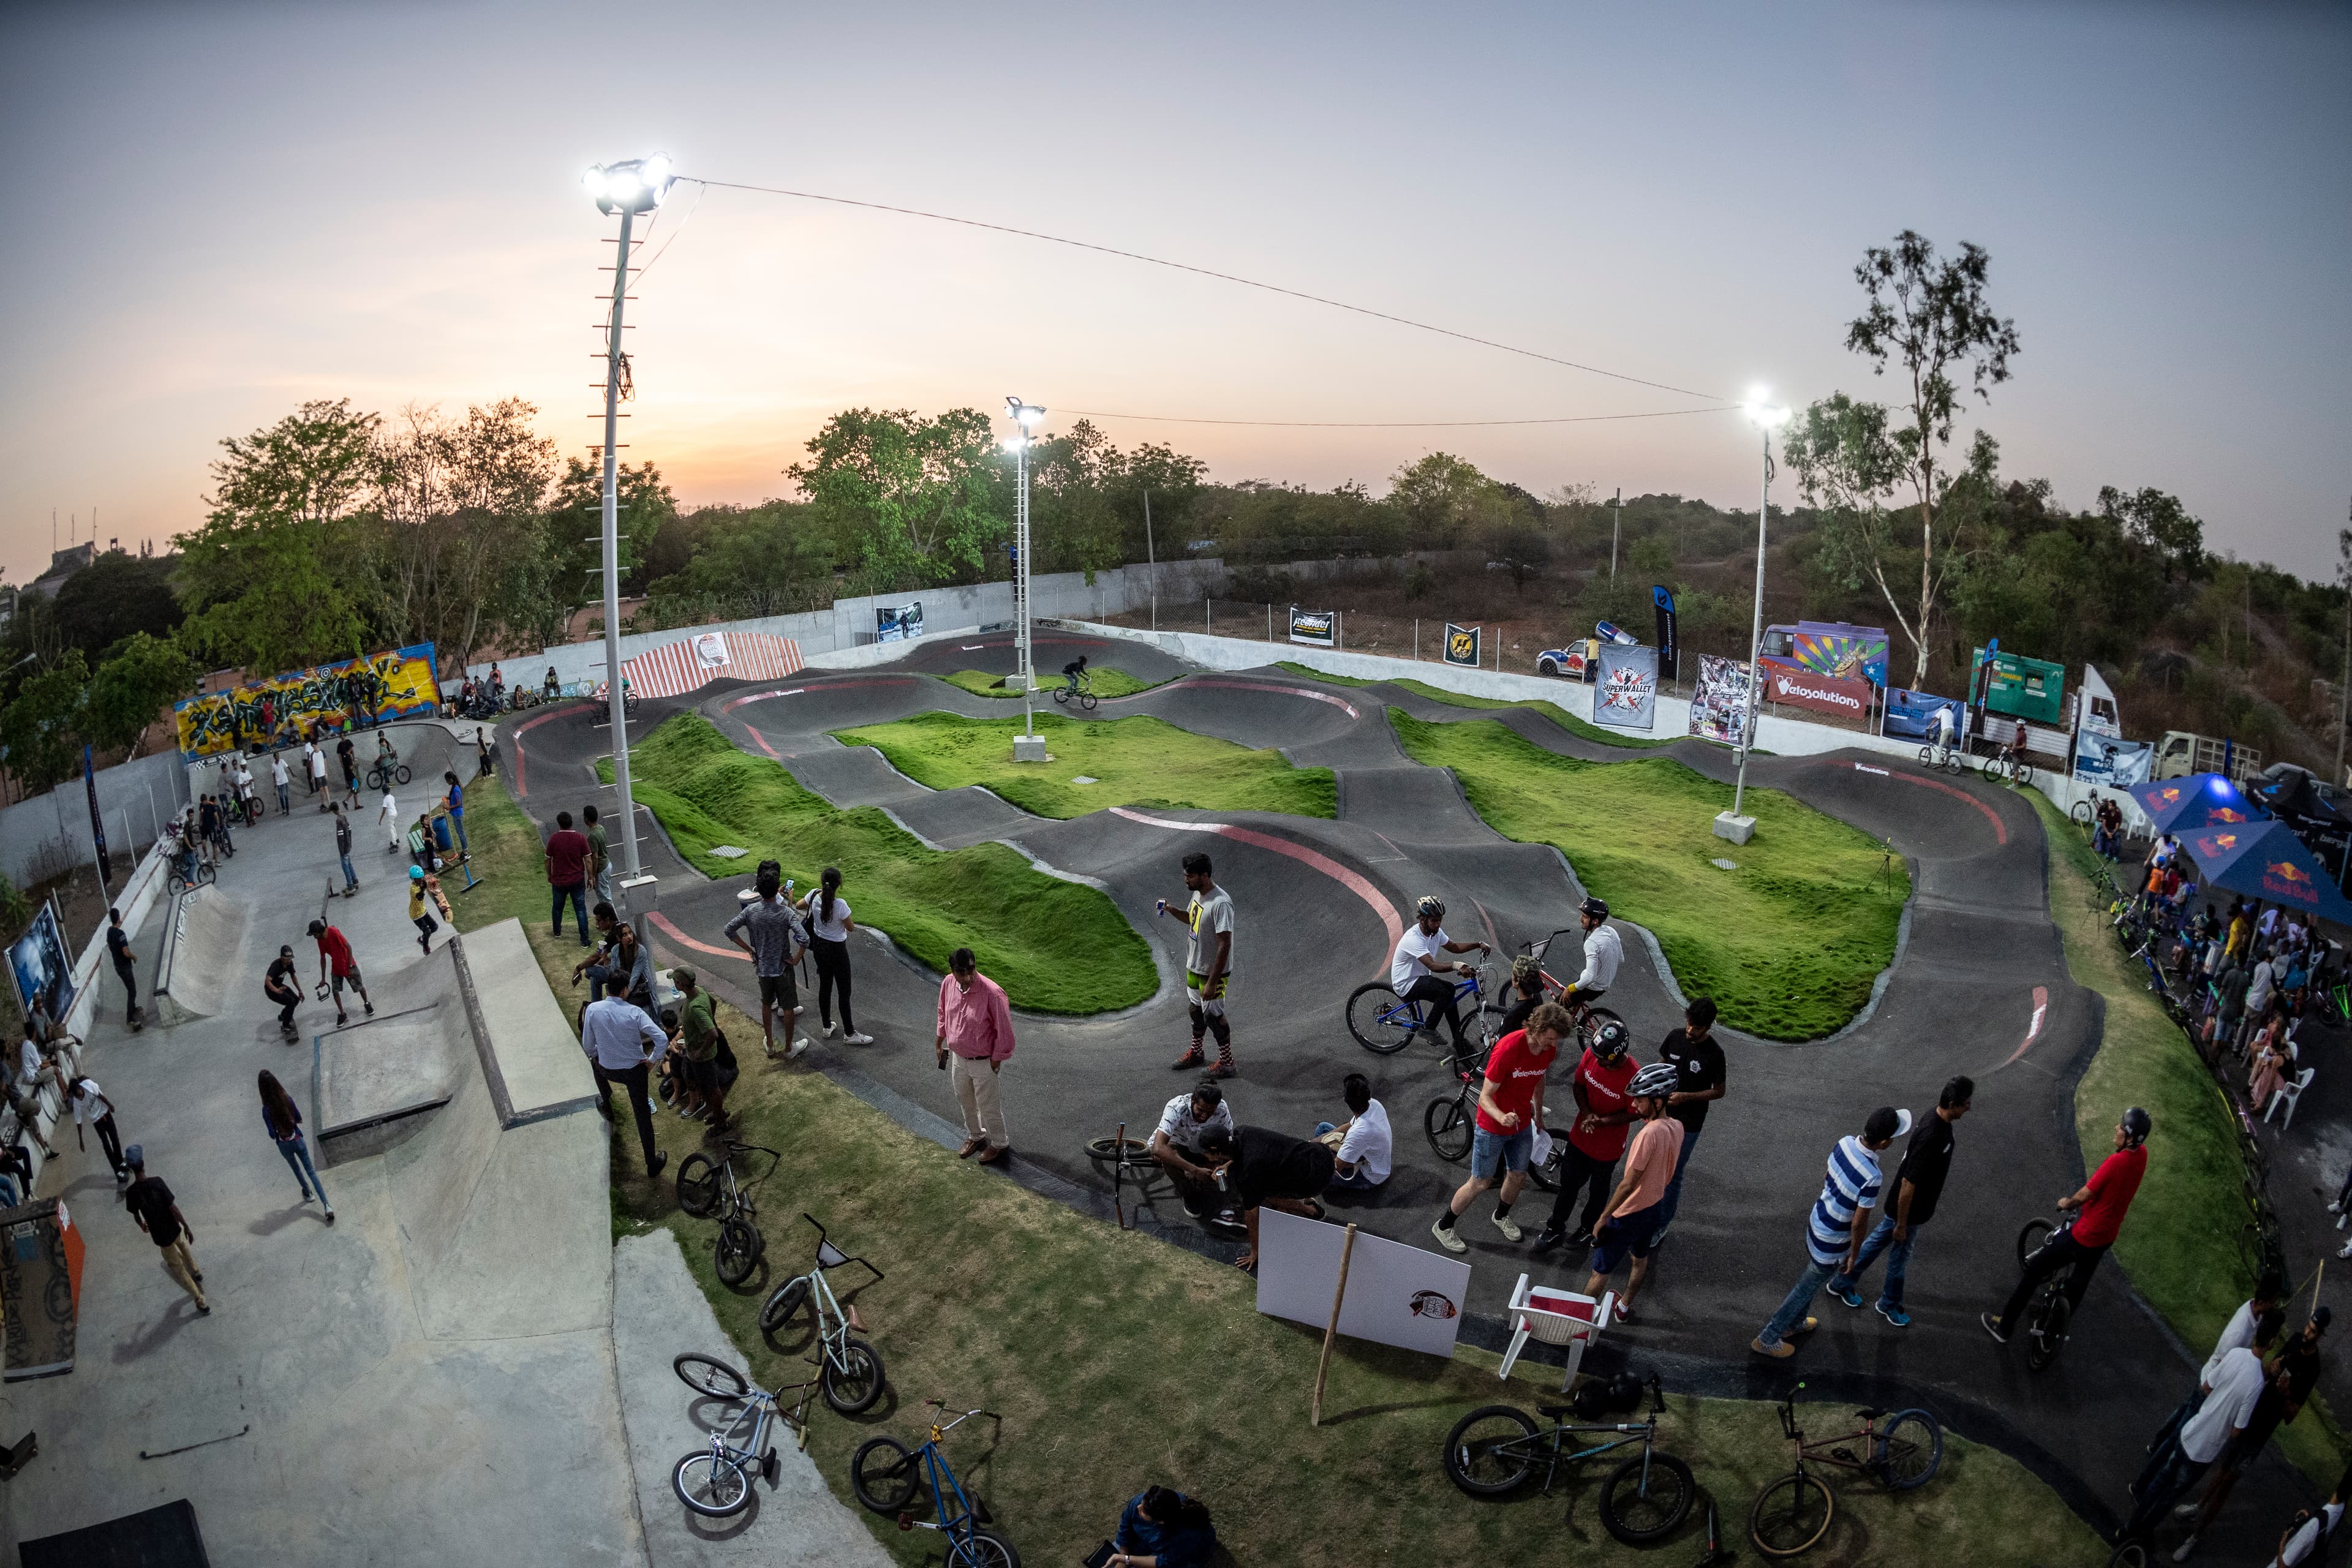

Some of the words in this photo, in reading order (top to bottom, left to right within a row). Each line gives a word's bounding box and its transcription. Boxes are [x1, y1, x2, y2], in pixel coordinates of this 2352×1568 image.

[1602, 682, 1652, 693] SUPERWALLET
[1776, 674, 1860, 709] Velosolutions
[2263, 875, 2292, 895] Red
[2292, 883, 2319, 904] Bull
[1434, 1298, 1443, 1316] PUMP
